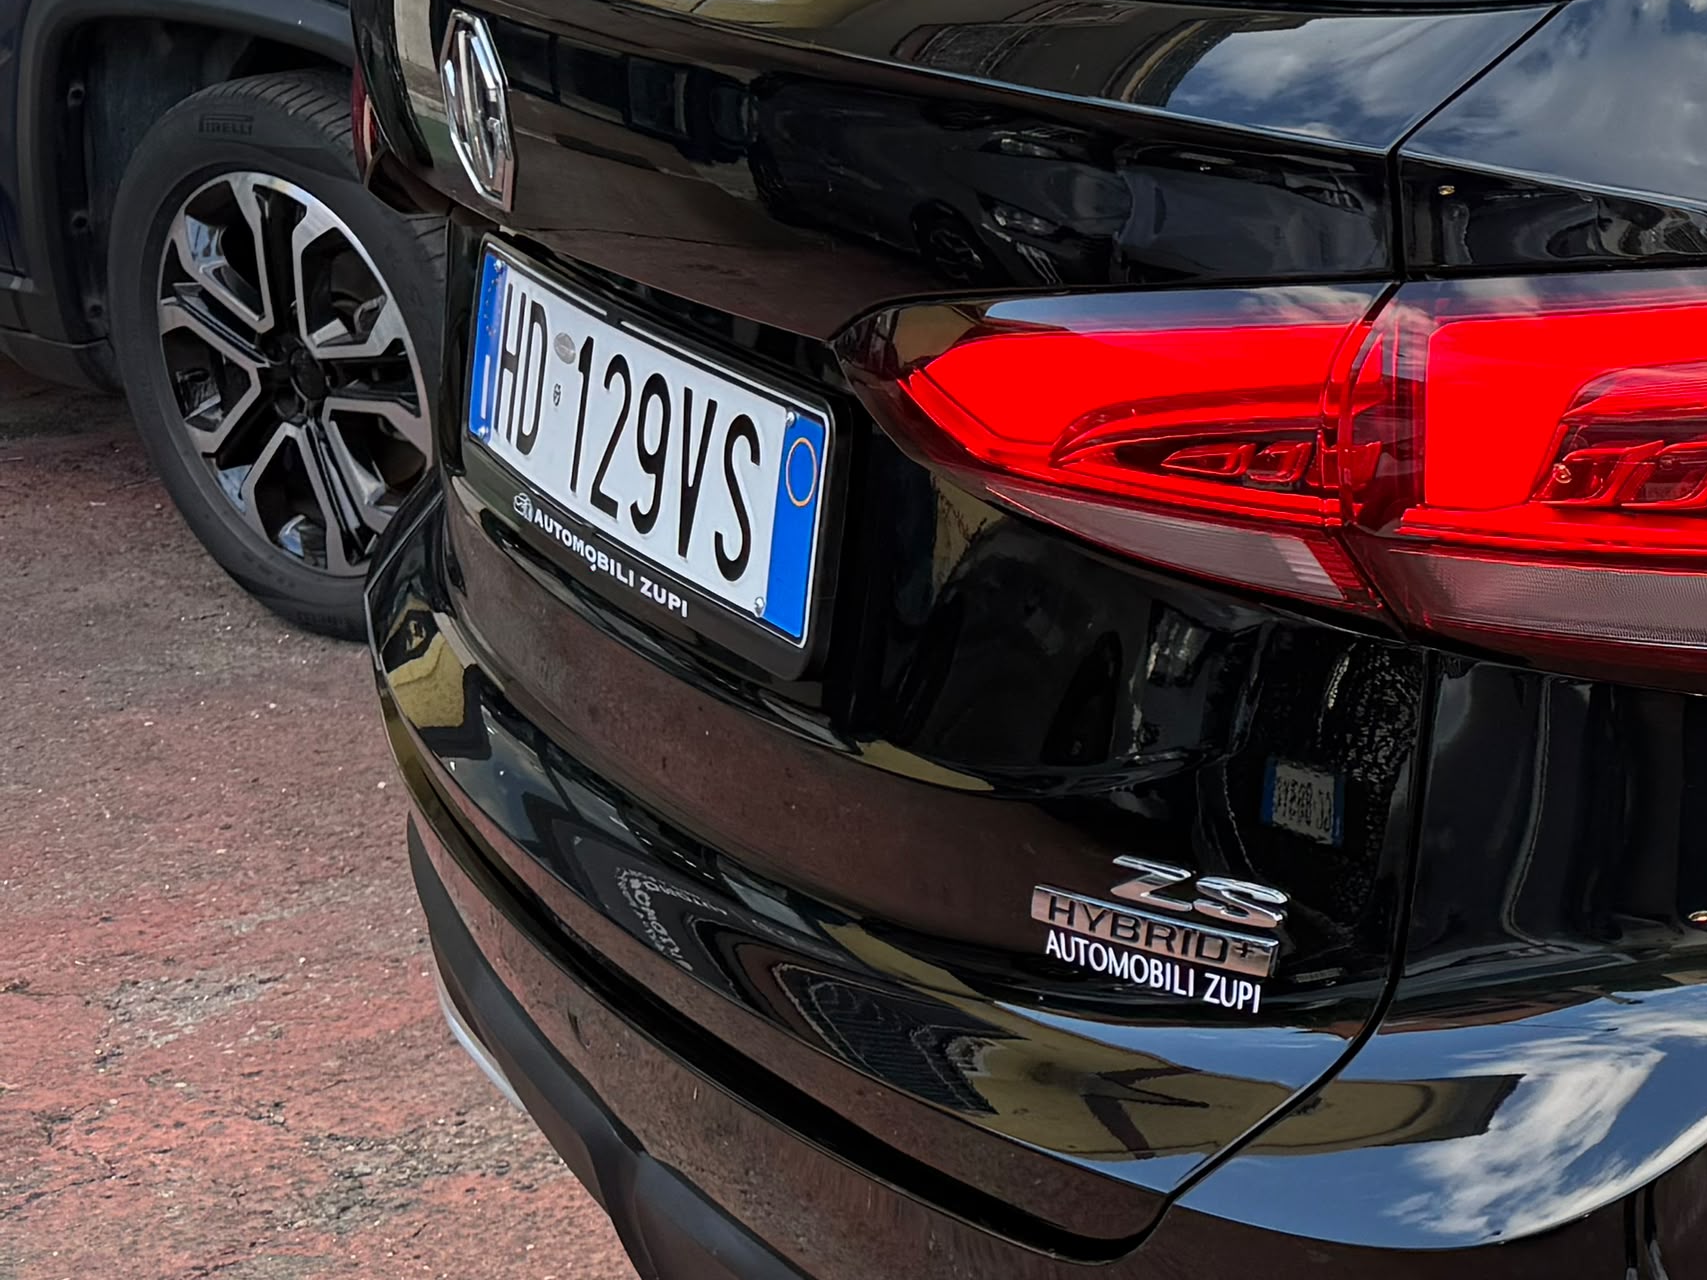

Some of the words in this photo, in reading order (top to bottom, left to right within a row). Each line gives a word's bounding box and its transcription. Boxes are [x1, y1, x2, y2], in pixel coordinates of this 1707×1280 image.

[494, 282, 549, 456] HD
[569, 334, 762, 583] 129VS
[533, 508, 636, 589] AUTOMOBILI
[638, 575, 689, 618] ZUPI
[1047, 894, 1262, 966] HYBRID+
[1110, 854, 1289, 929] ZS
[1045, 929, 1196, 998] AUTOMOBILI
[1202, 972, 1262, 1015] ZUPI
